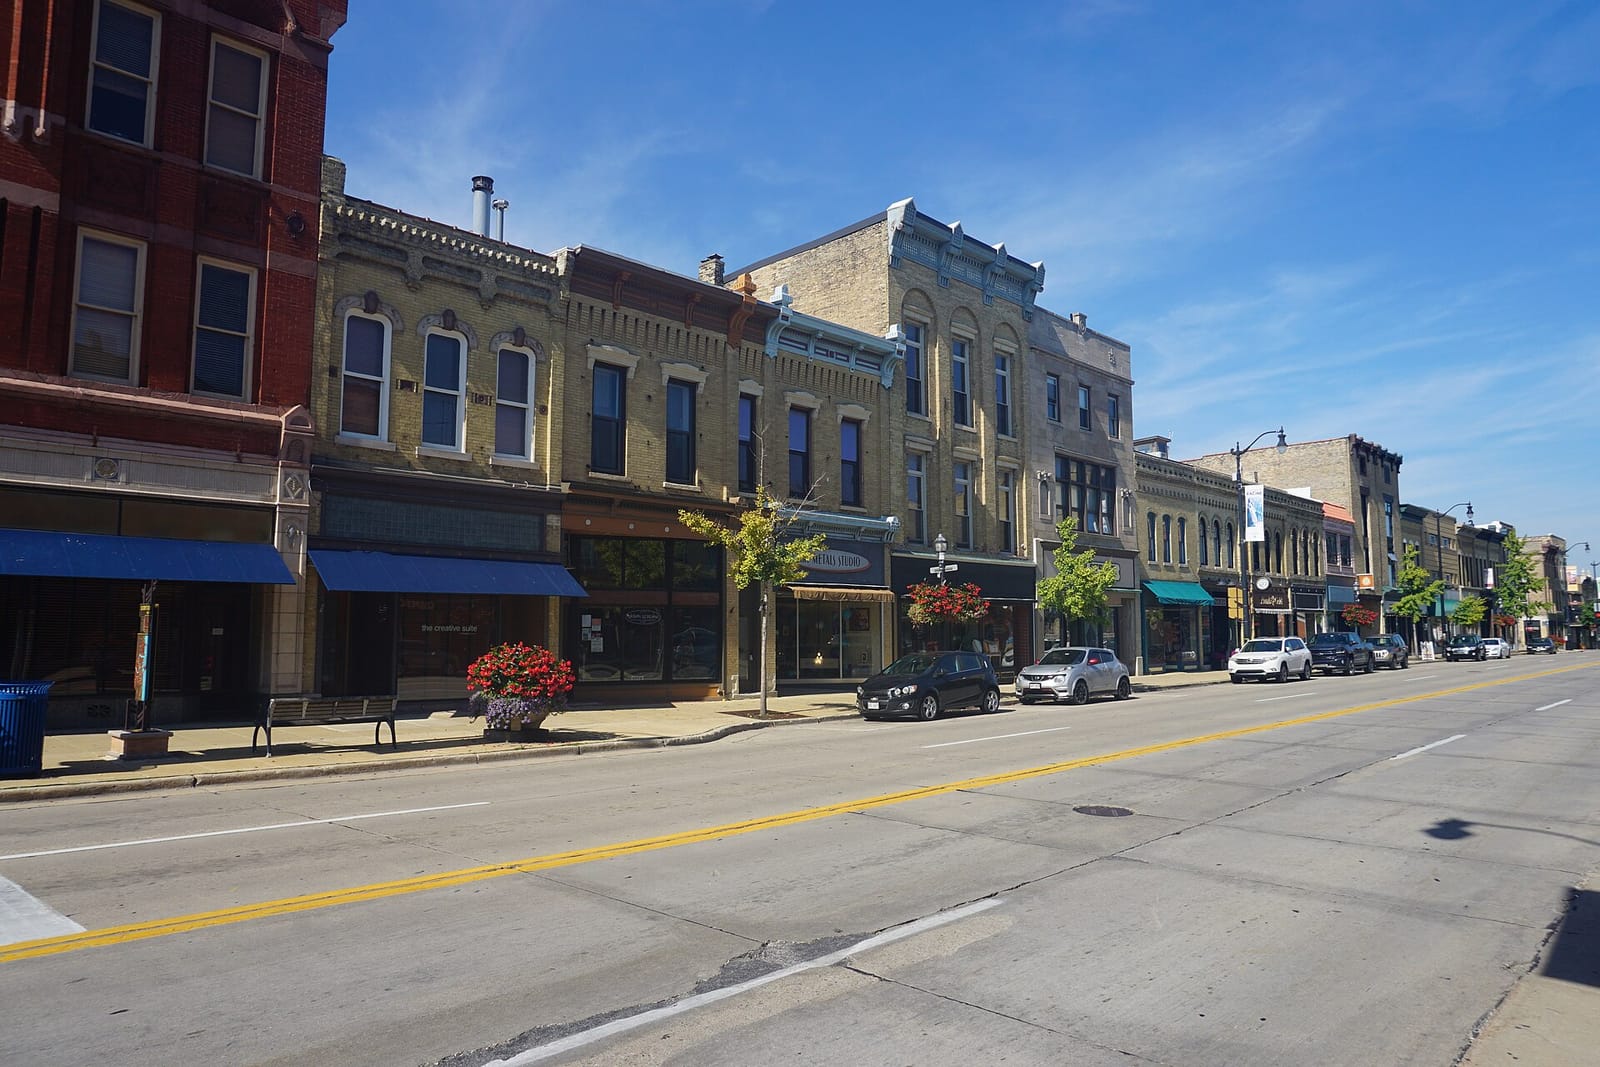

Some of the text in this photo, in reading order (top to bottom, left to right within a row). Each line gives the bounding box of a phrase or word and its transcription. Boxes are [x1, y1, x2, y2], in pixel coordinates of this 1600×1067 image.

[838, 555, 861, 568] STUDIO
[421, 624, 478, 632] the creative suite
